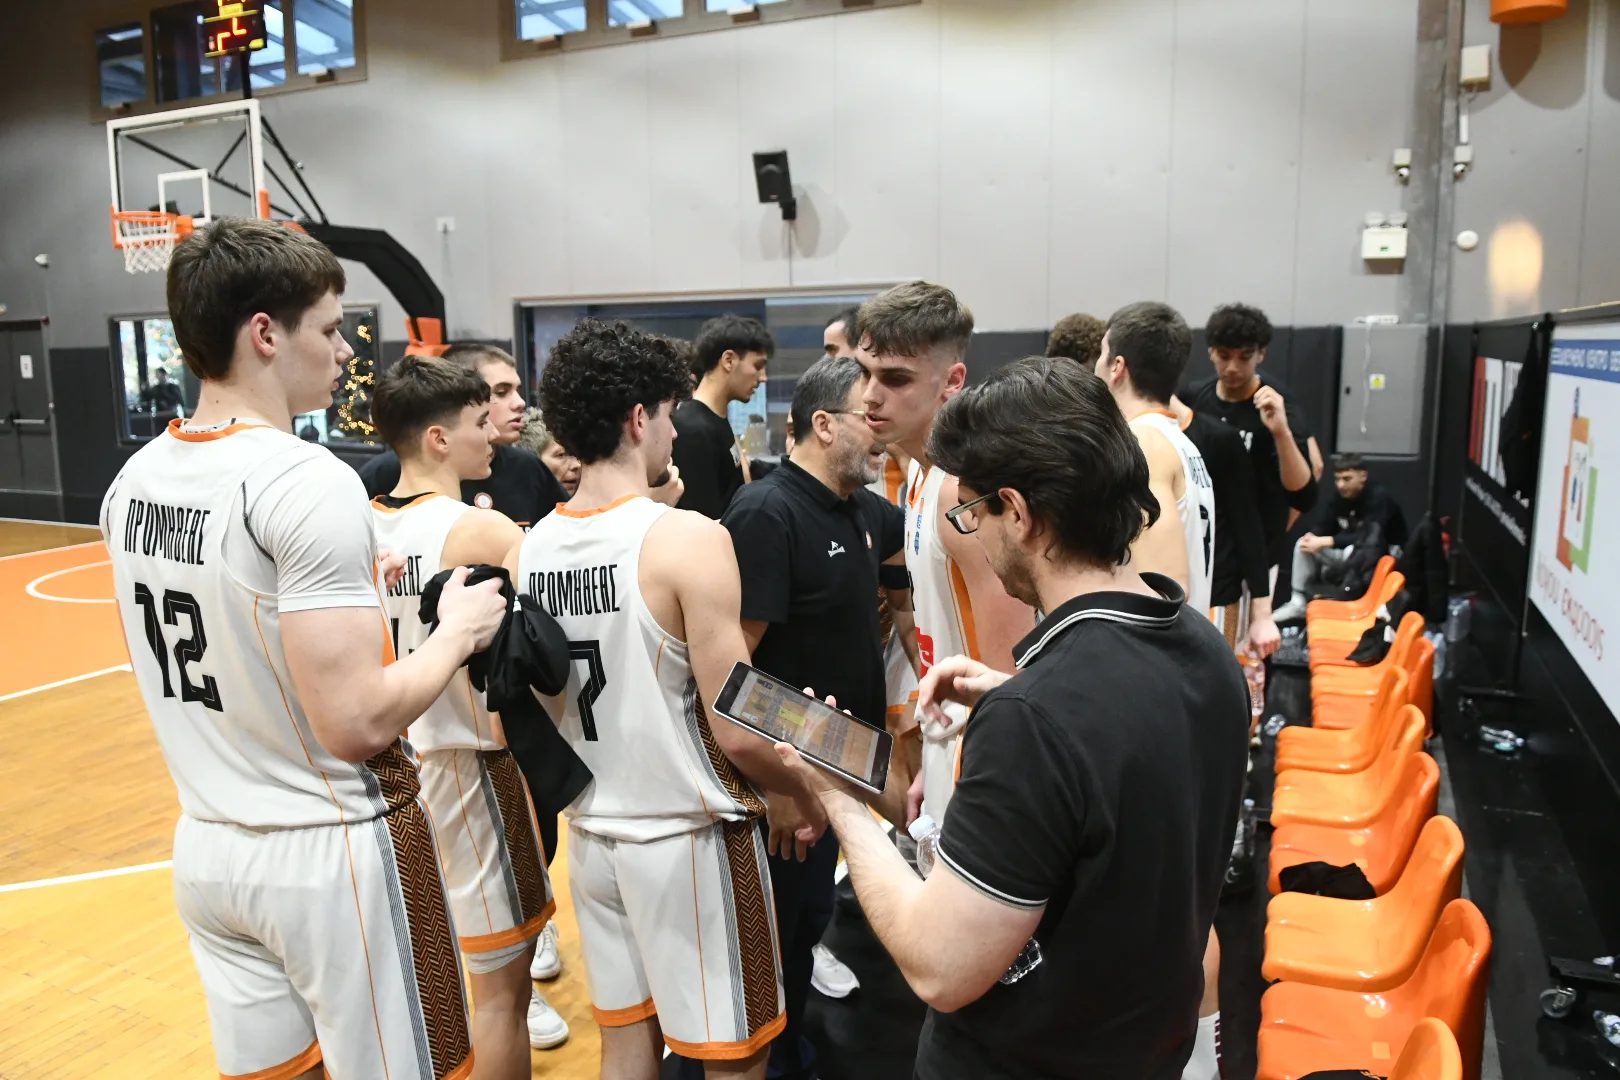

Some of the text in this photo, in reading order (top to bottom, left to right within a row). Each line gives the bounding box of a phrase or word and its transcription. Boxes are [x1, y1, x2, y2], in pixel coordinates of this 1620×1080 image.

[124, 498, 211, 566] ΠΡΟΜΗΘΕΑΣ
[529, 564, 621, 618] ΠΡΟΜΗΘΕΑΣ
[134, 581, 224, 713] 12
[567, 639, 607, 742] 7
